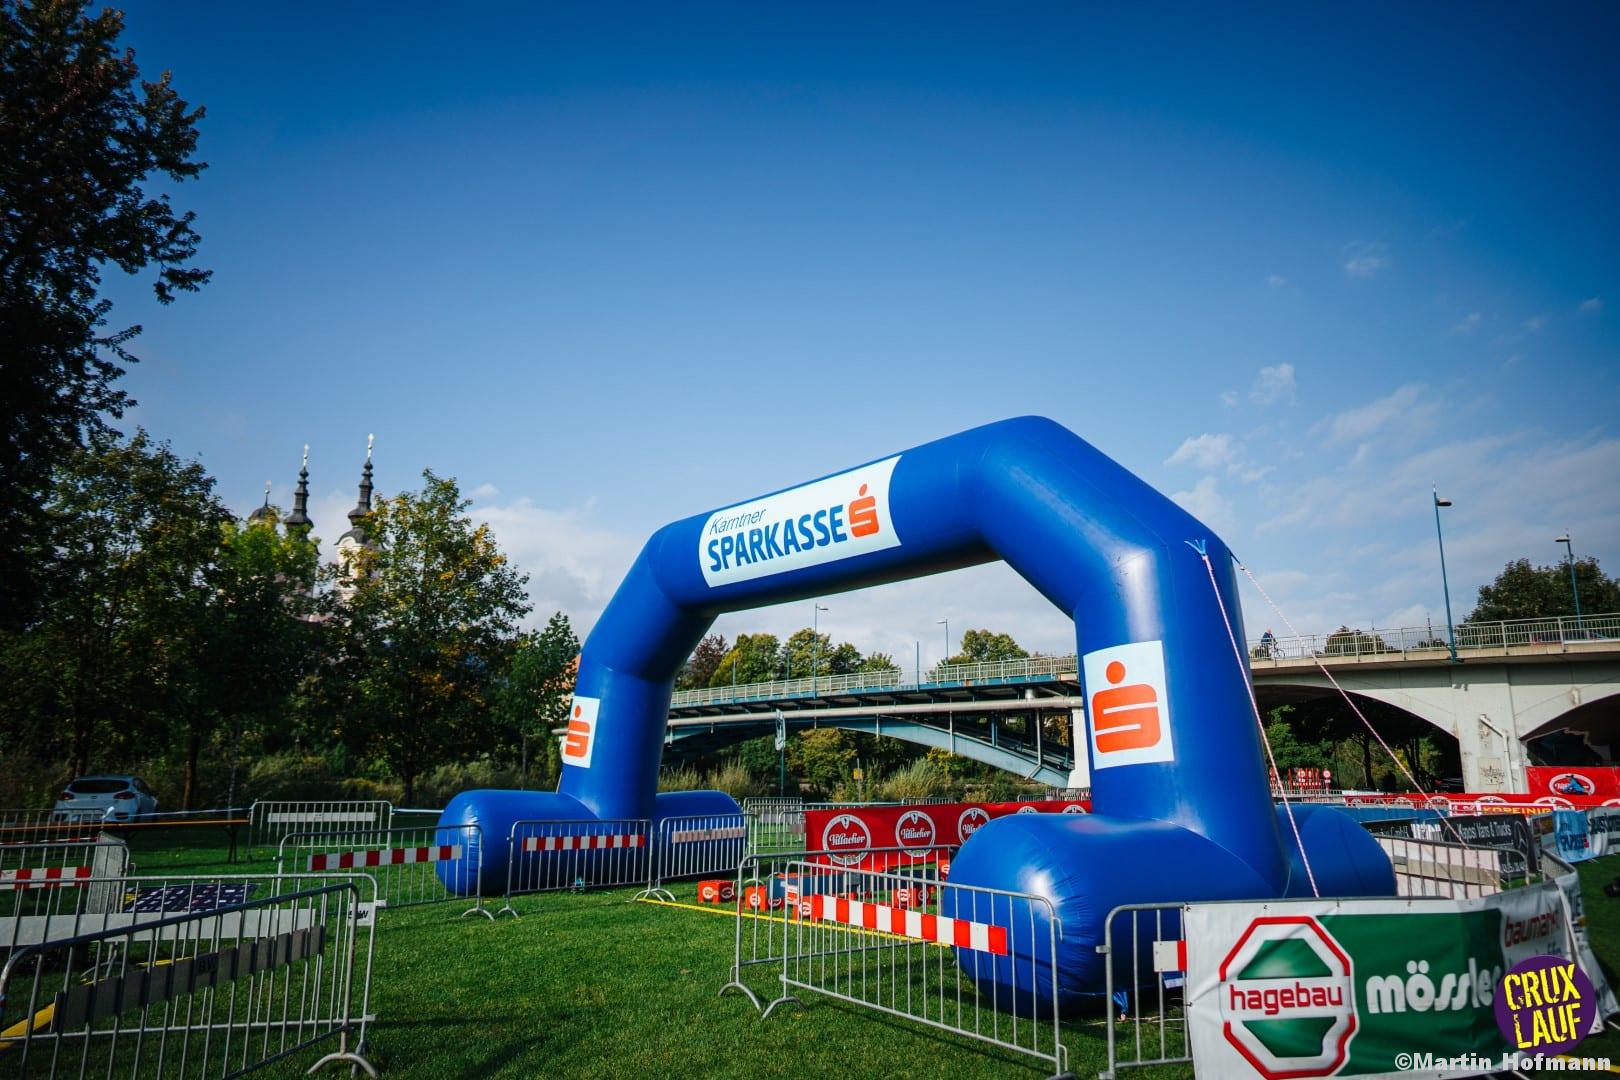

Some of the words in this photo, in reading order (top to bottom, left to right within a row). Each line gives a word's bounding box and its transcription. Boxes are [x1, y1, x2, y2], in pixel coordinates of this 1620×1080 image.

[707, 504, 848, 572] SPARKASSE
[829, 832, 866, 846] Villacher
[900, 827, 931, 840] Villacher
[1229, 981, 1343, 1015] hagebau
